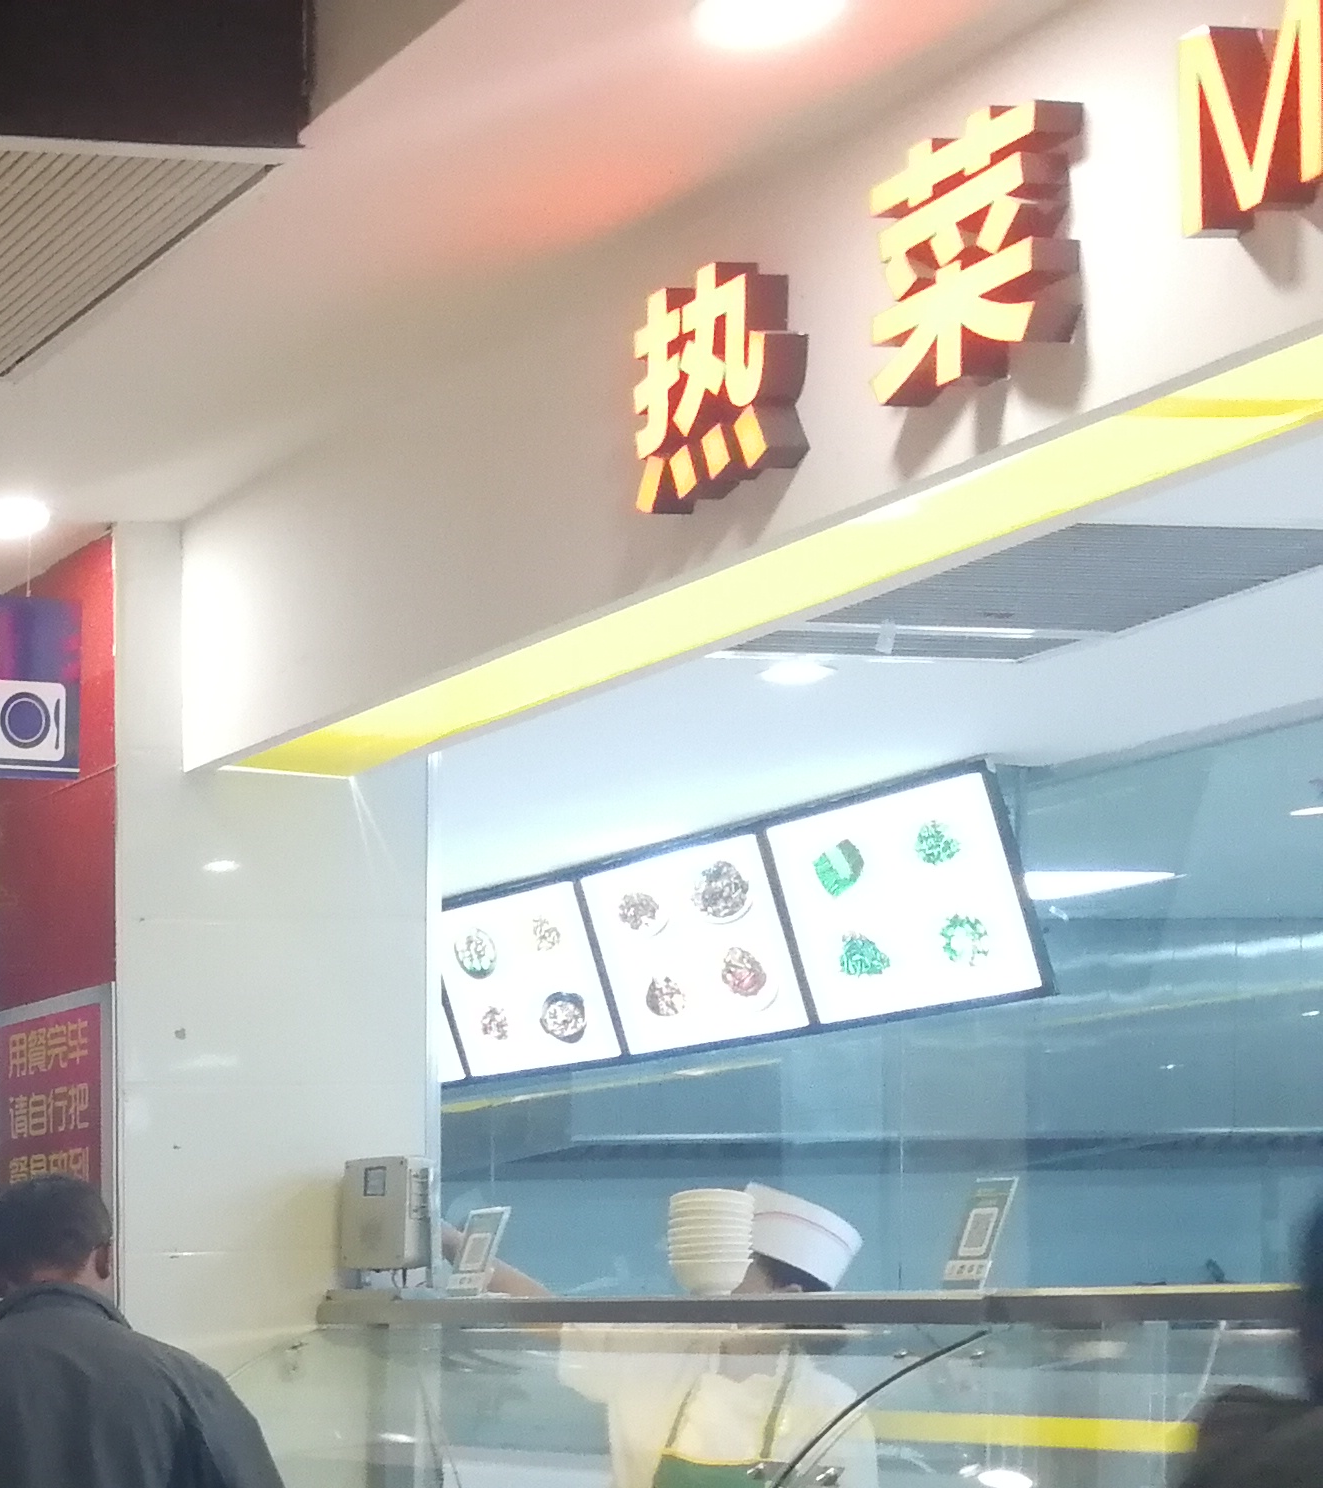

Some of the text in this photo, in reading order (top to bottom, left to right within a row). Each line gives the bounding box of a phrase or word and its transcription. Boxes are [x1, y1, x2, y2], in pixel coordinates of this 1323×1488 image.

[635, 100, 1055, 513] 热菜
[8, 1018, 89, 1079] 用餐完毕
[9, 1083, 90, 1139] 请自行把
